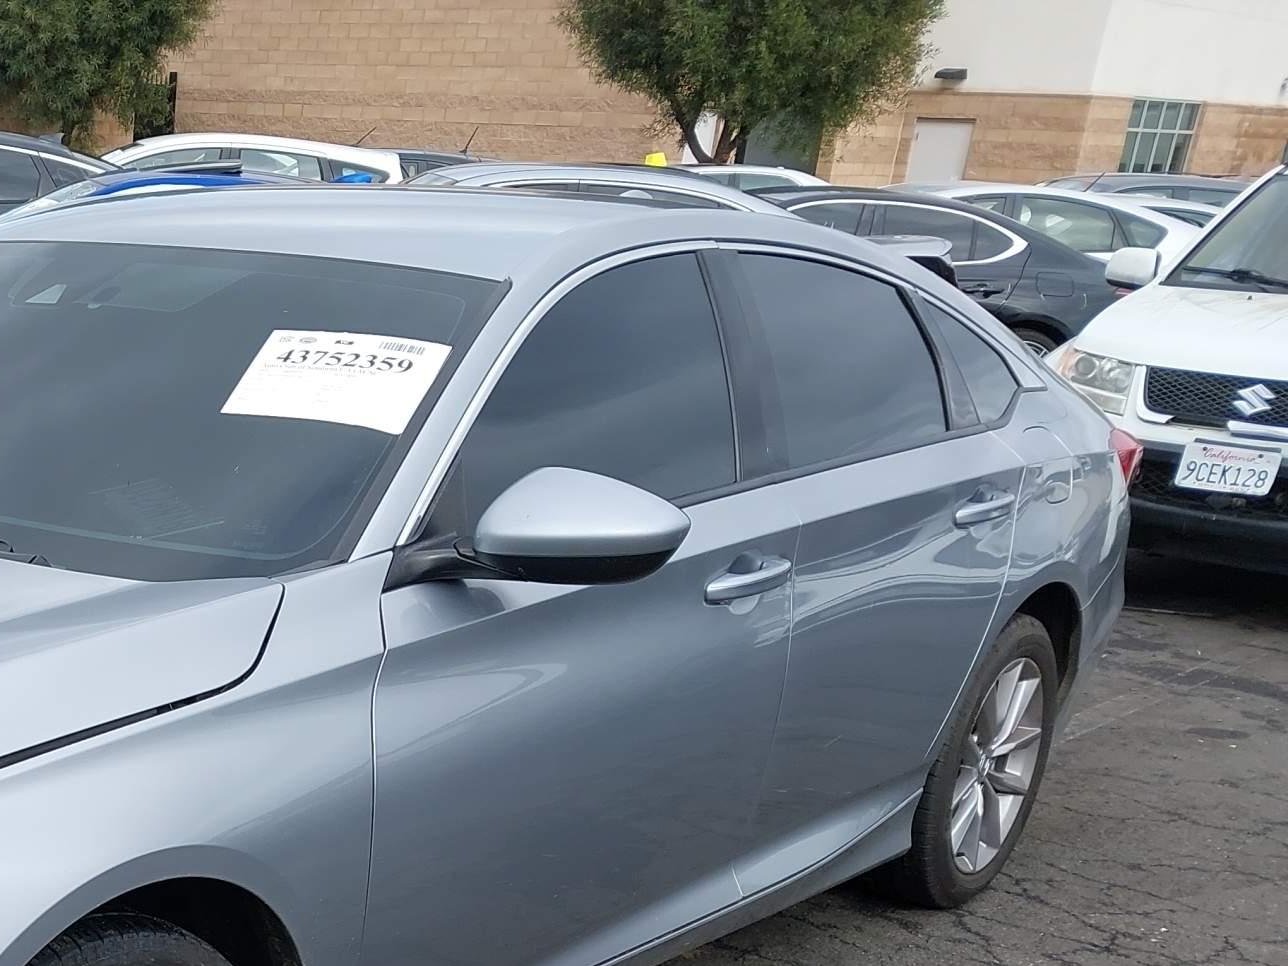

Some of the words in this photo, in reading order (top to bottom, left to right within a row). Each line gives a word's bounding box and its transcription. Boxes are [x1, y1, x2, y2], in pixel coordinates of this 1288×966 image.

[275, 347, 414, 374] 43752359
[1202, 447, 1257, 464] California
[1181, 459, 1270, 489] 9CEK128
